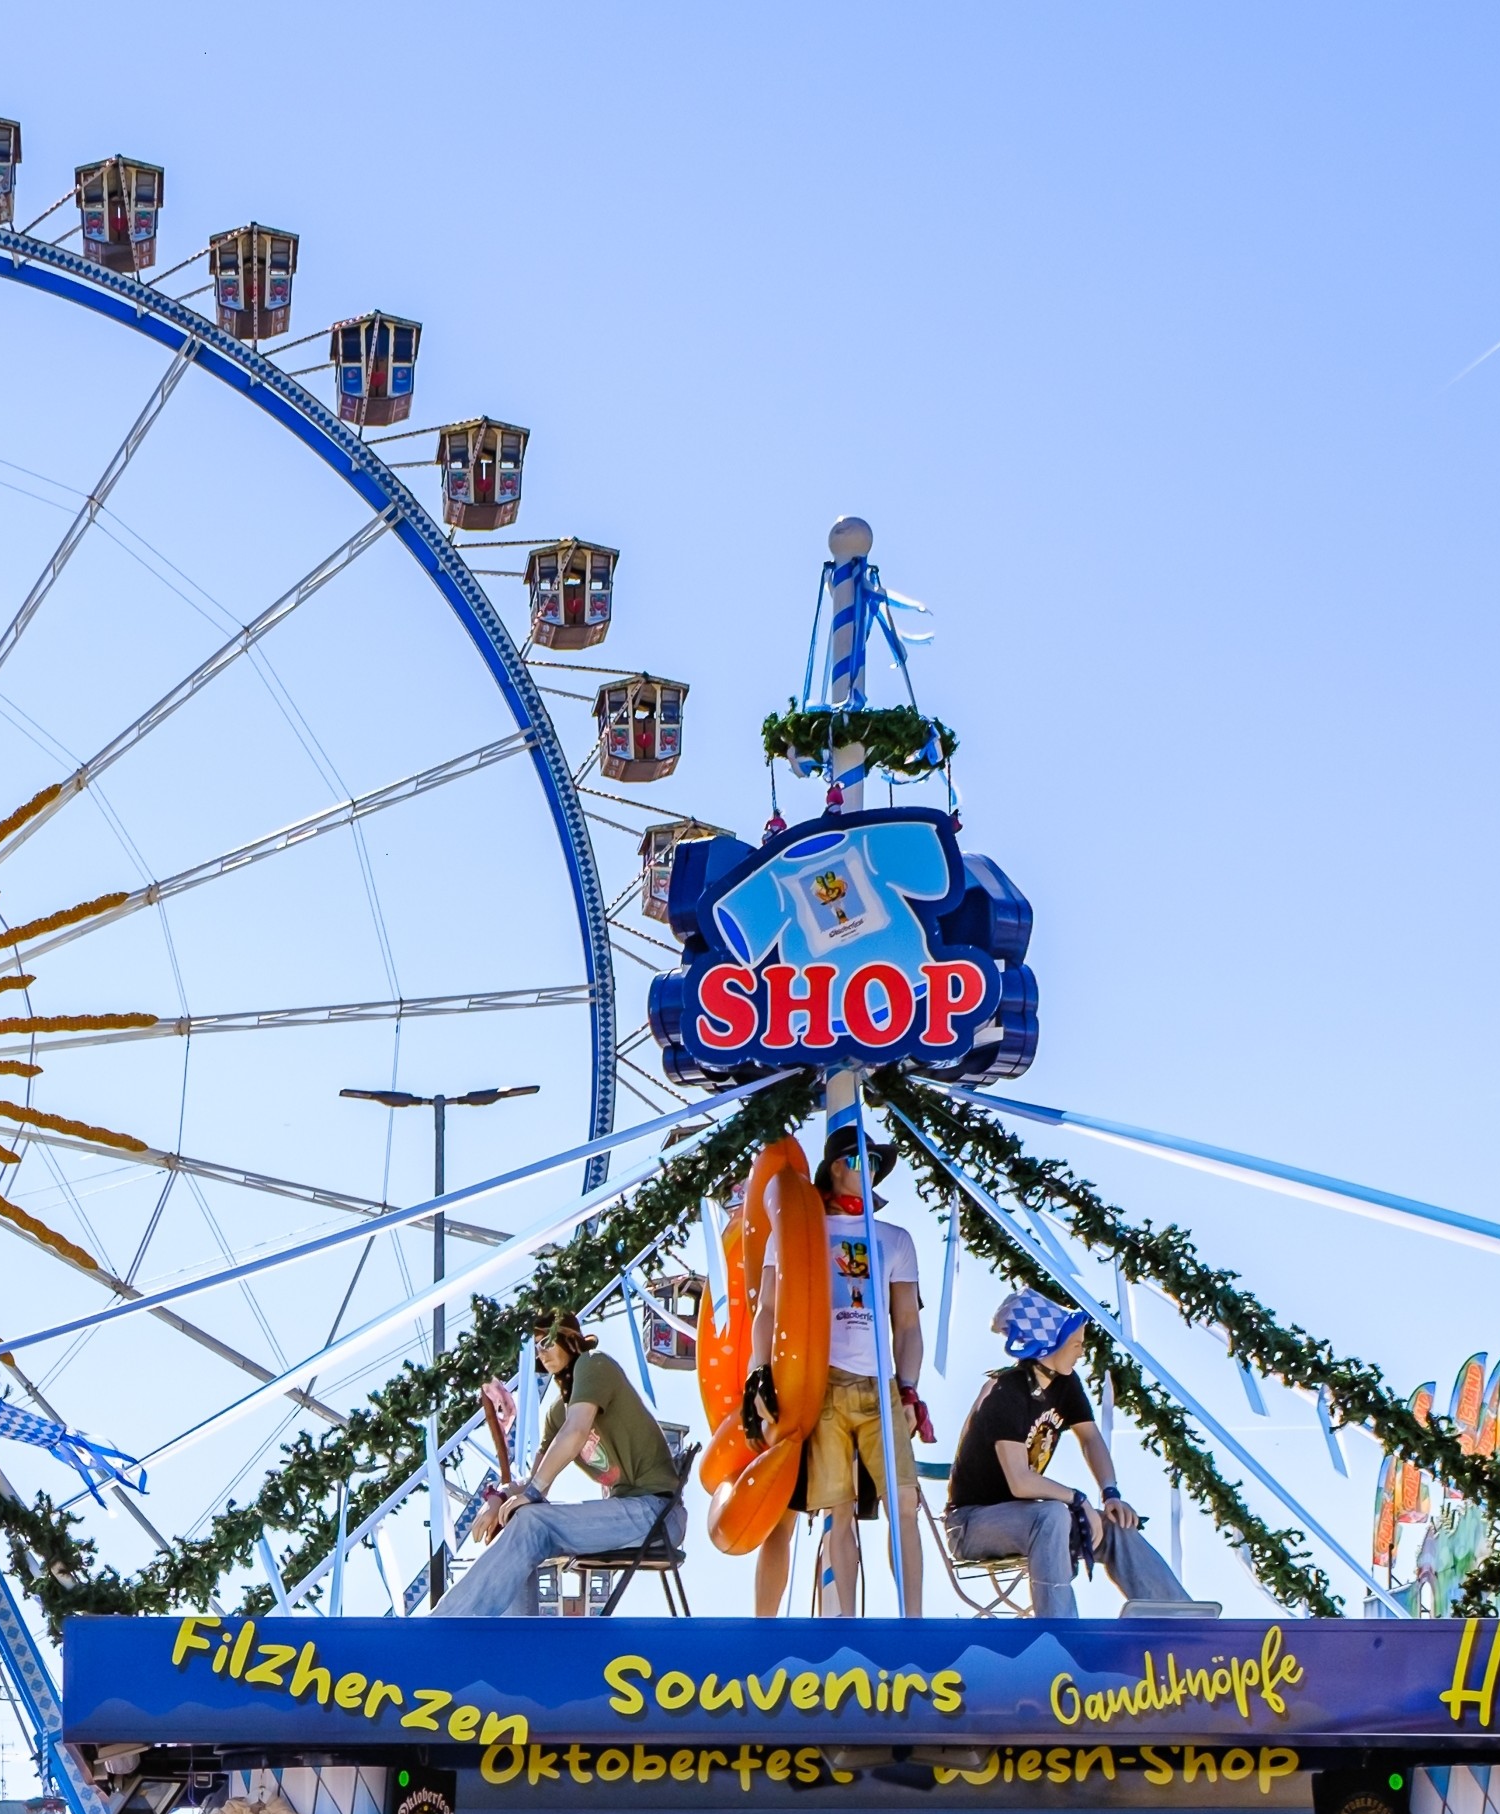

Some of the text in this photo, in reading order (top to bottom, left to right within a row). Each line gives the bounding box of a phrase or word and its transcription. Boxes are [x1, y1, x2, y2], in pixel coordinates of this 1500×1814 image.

[697, 960, 987, 1051] SHOP
[1457, 1364, 1483, 1427] ISLAND
[172, 1618, 528, 1744] Filzherzen
[603, 1654, 966, 1716] Souvenirs
[931, 1744, 1300, 1793] Wiesn-Shop
